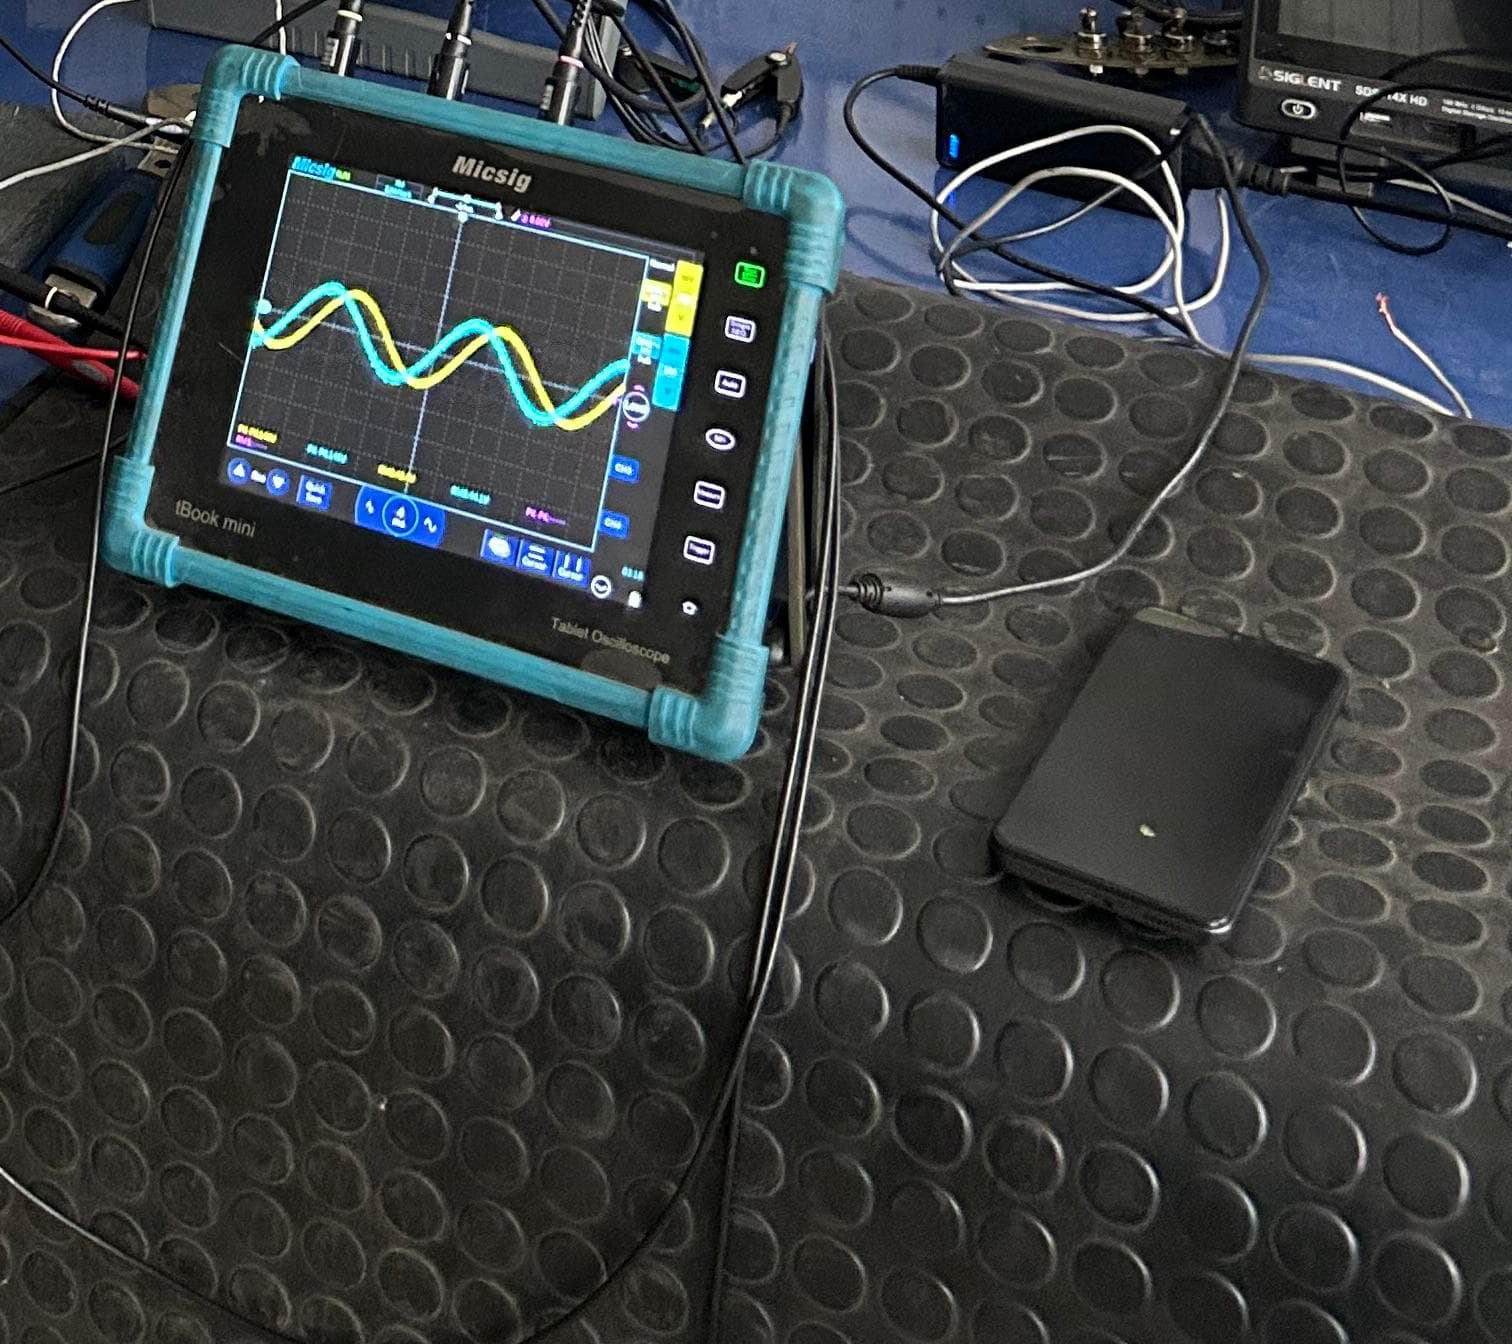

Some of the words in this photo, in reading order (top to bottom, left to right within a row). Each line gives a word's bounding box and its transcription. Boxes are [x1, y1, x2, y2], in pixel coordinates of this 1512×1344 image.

[1273, 69, 1343, 92] SIGLENT
[1409, 93, 1429, 108] HD
[291, 155, 338, 181] Micsig
[451, 154, 533, 194] Micsig
[221, 517, 257, 539] mini
[551, 616, 590, 640] Tablet
[591, 629, 671, 665] Oscilloscope
